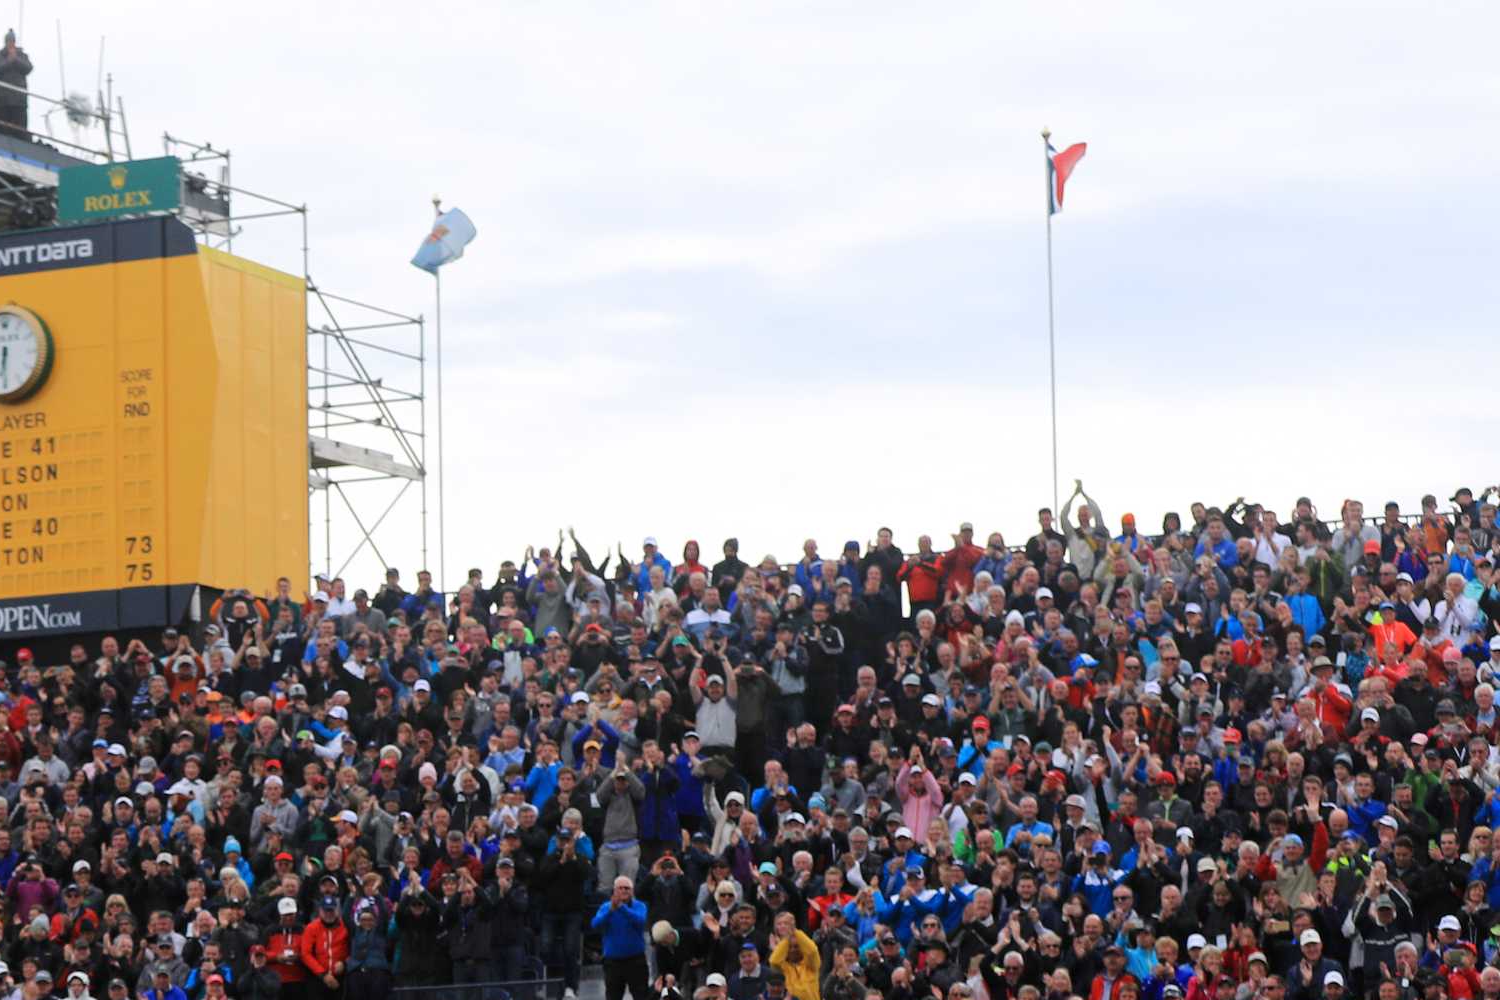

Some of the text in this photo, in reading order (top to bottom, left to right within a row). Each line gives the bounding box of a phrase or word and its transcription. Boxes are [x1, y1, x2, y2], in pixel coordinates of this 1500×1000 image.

[84, 191, 152, 212] ROLEX
[120, 368, 153, 383] SCORE
[127, 385, 148, 399] FOR
[124, 402, 151, 418] RND
[31, 437, 57, 455] 41
[32, 517, 59, 536] 40
[125, 536, 153, 555] 73
[125, 563, 154, 582] 75
